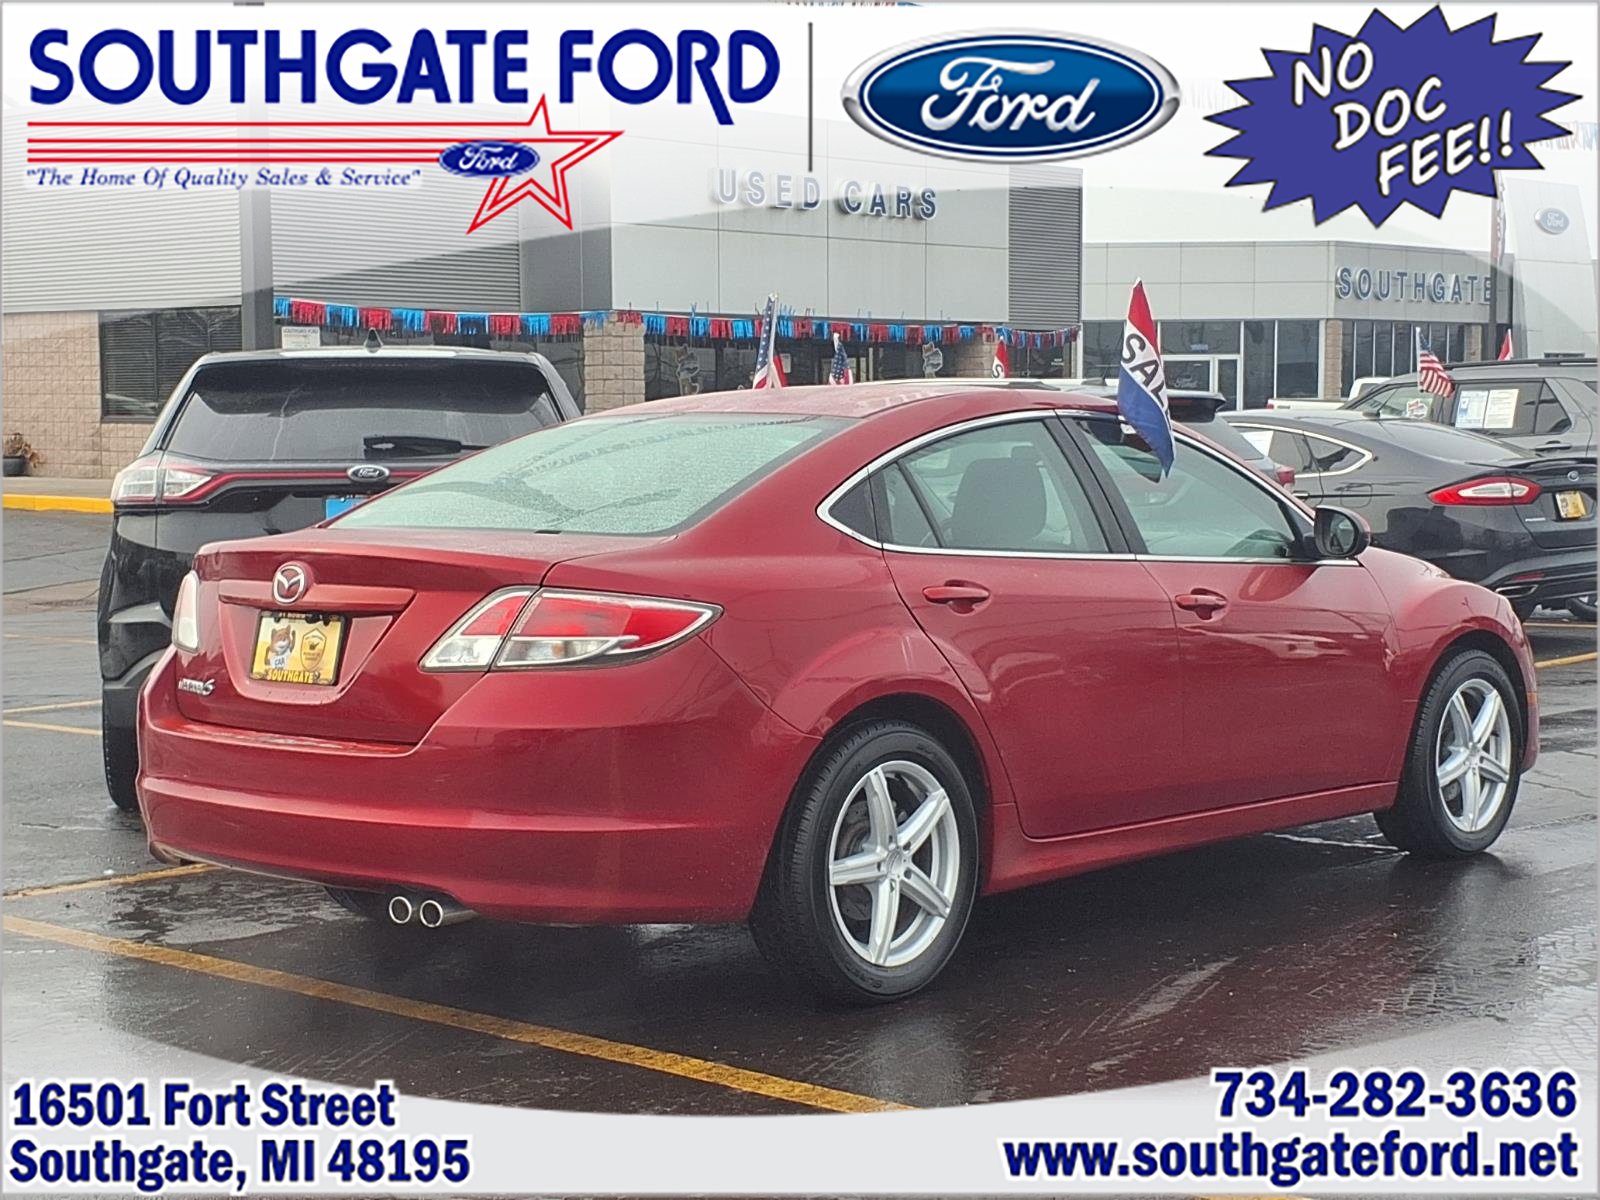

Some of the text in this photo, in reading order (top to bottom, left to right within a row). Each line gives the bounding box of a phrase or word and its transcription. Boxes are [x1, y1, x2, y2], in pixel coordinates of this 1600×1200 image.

[718, 168, 937, 219] USED CARS
[1336, 267, 1492, 304] SOUTHGATE
[1121, 332, 1172, 432] SAL
